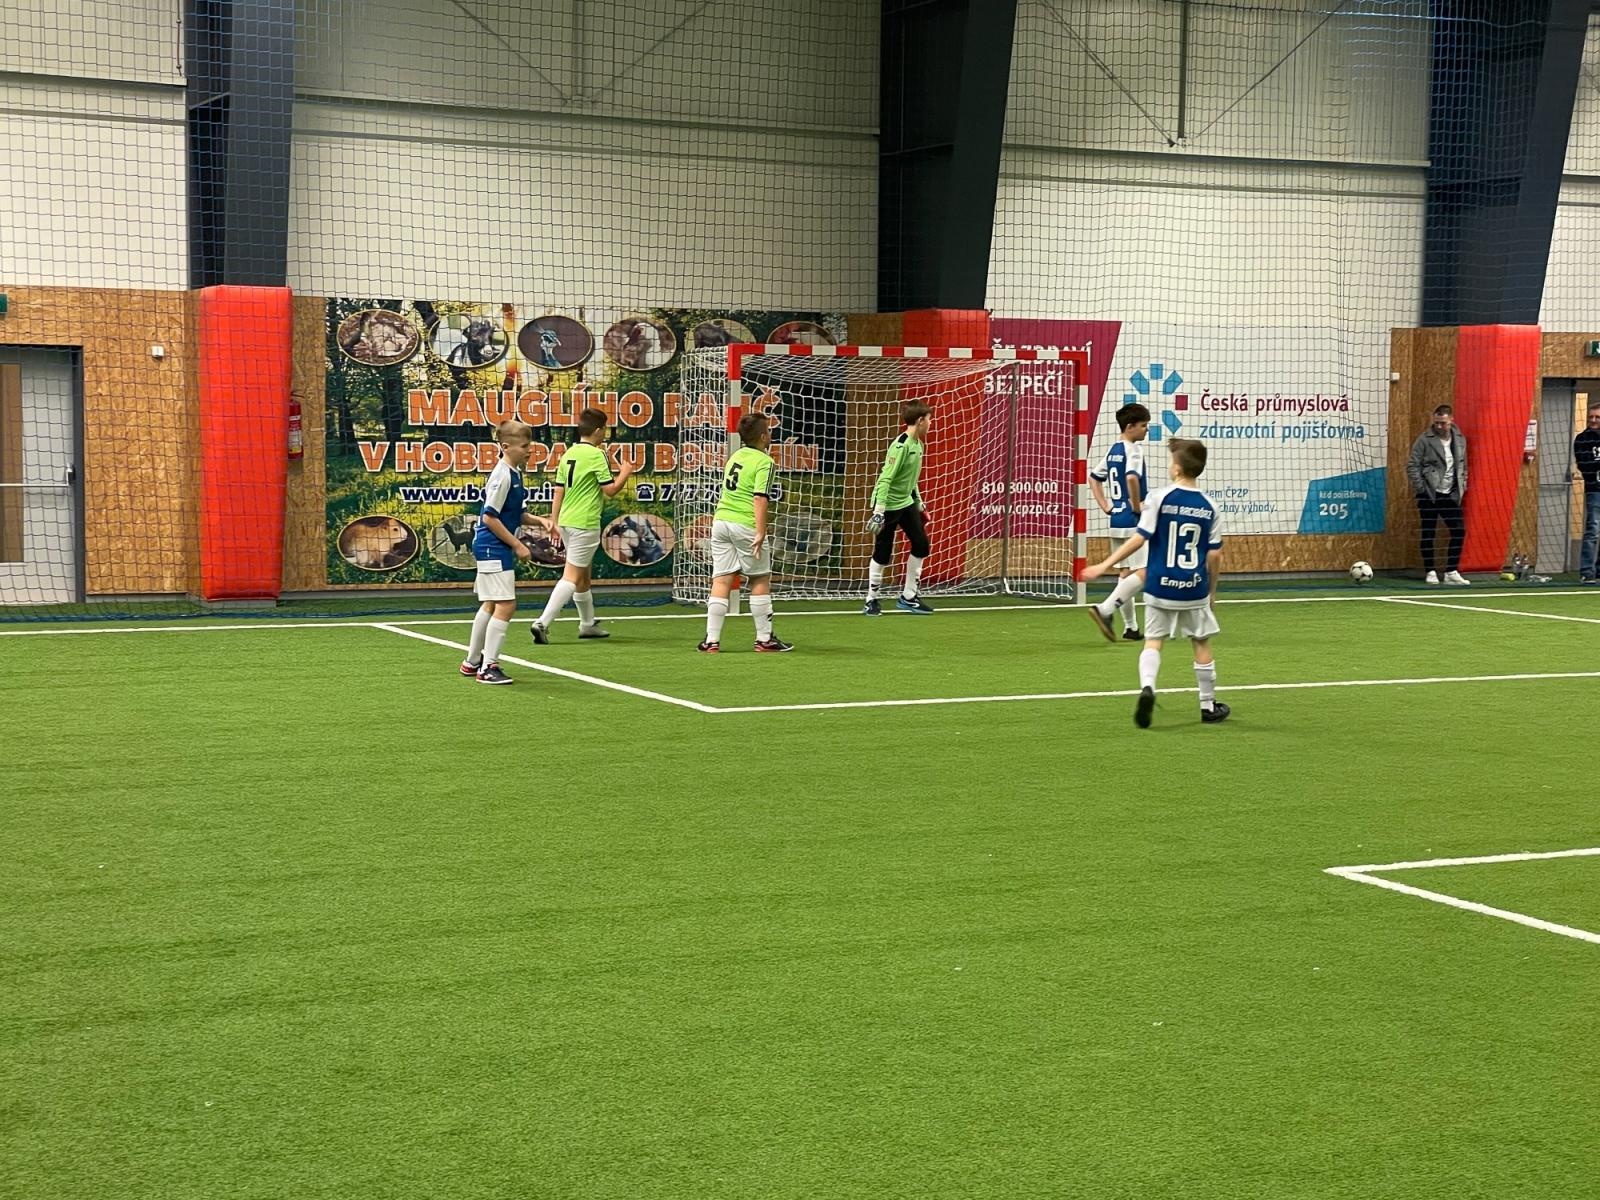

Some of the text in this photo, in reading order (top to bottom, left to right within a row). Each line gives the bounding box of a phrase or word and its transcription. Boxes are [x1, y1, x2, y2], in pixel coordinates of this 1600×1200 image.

[407, 382, 654, 428] MAUGLÍHO
[1200, 388, 1349, 417] Česká průmyslová
[1199, 420, 1365, 443] zdravotní pojišťovna
[359, 441, 390, 473] V
[395, 441, 503, 473] HOBB
[566, 459, 577, 488] 7
[725, 462, 744, 491] 5
[1034, 481, 1058, 494] 000
[1109, 467, 1122, 500] 6
[1225, 486, 1249, 498] ČPZP
[1319, 503, 1348, 520] 205
[1166, 520, 1202, 570] 13
